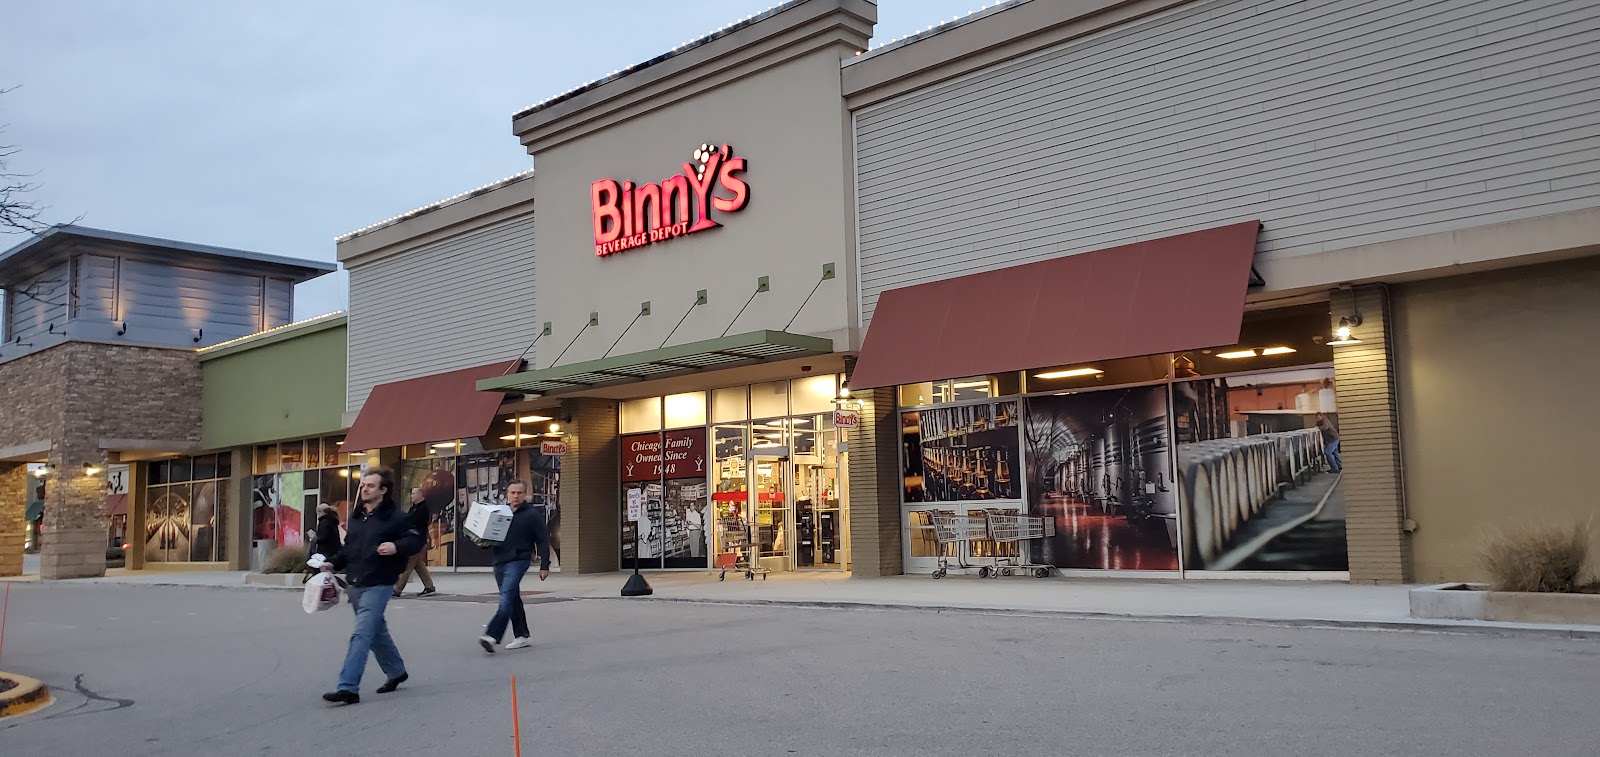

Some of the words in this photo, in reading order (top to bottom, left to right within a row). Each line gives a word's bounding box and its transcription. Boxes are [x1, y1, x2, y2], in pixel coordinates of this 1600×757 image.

[596, 232, 648, 256] BEVERAGE
[650, 221, 688, 243] DEPOT
[631, 441, 662, 452] Chicago
[665, 437, 694, 449] Family
[665, 450, 688, 461] Since
[652, 463, 676, 475] 1948
